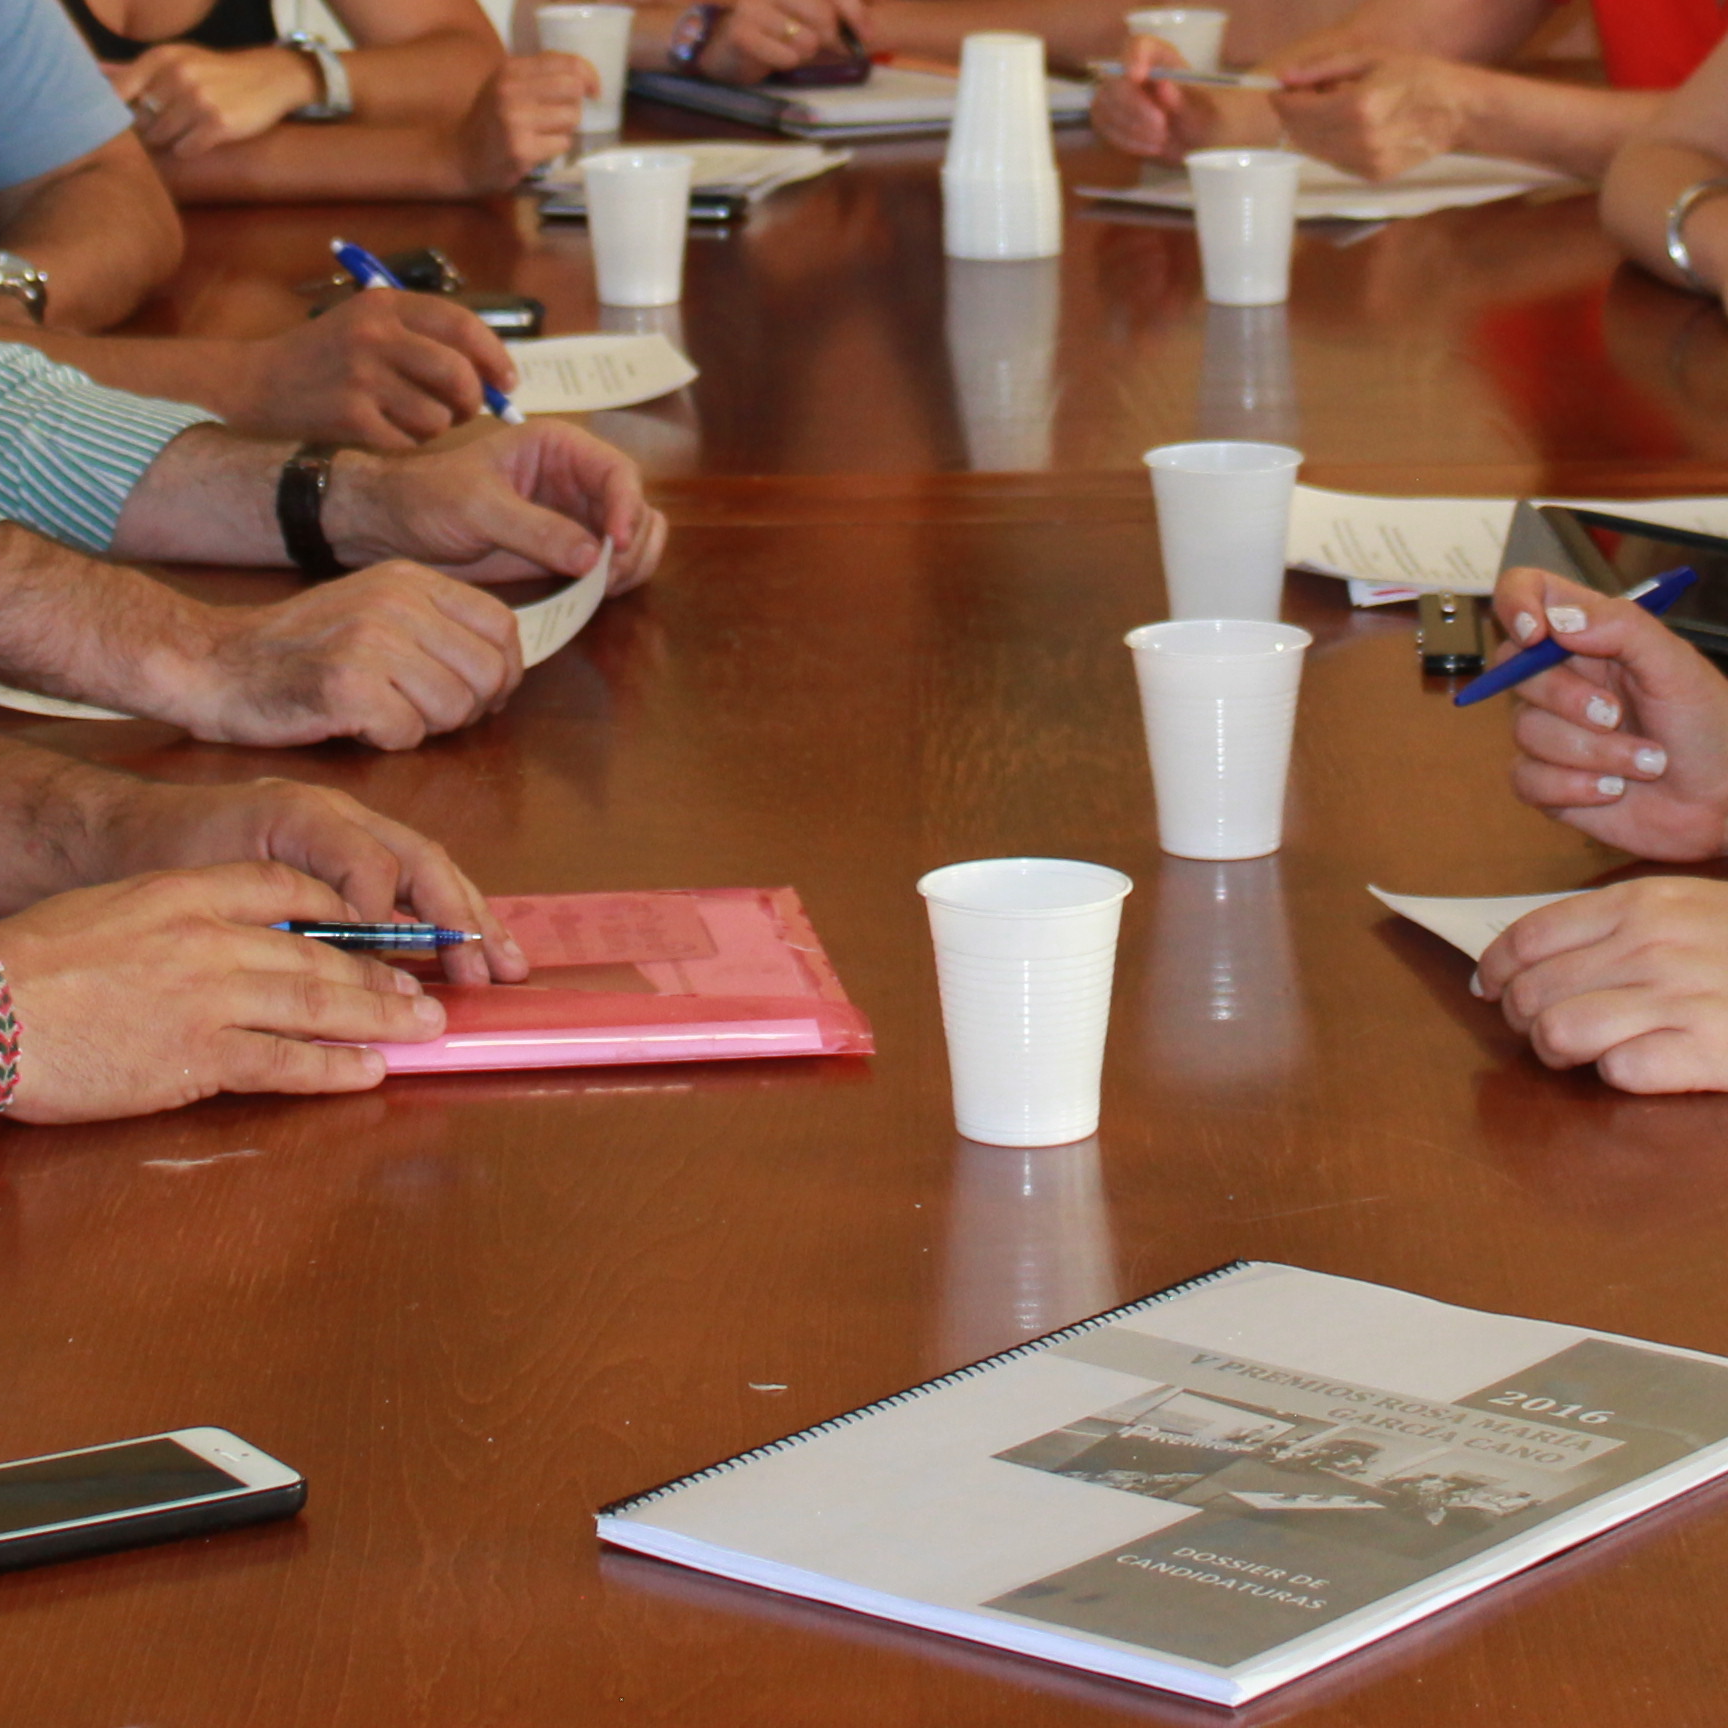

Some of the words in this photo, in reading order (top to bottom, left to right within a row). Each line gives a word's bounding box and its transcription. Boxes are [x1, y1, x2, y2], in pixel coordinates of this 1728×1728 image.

[1189, 1352, 1217, 1367] V
[1217, 1358, 1377, 1403] PREMIOS
[1374, 1396, 1467, 1425] ROSA
[1472, 1417, 1596, 1453] MARÍA
[1487, 1390, 1617, 1426] 2016
[1328, 1407, 1460, 1444] GARCÍA
[1463, 1434, 1568, 1466] CANO
[1116, 1554, 1328, 1610] CANDIDATURAS
[1173, 1546, 1287, 1581] DOSSIER
[1288, 1574, 1330, 1590] DE
